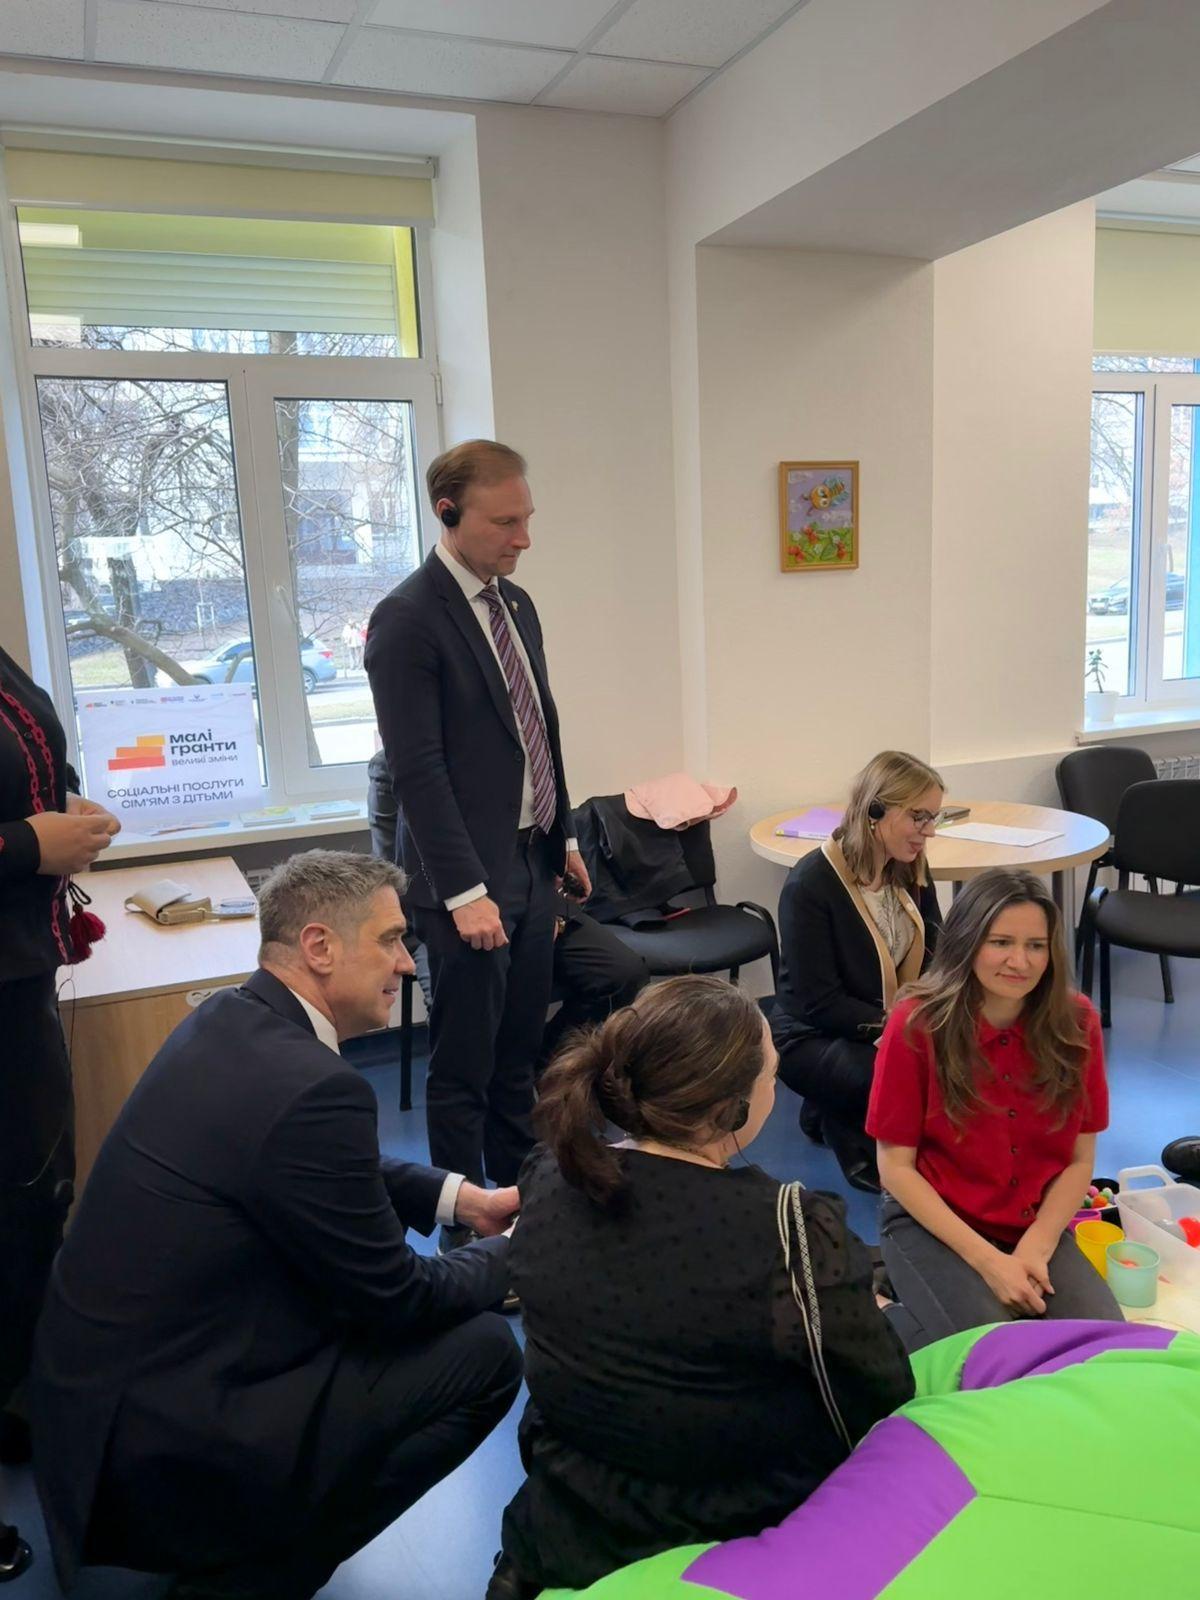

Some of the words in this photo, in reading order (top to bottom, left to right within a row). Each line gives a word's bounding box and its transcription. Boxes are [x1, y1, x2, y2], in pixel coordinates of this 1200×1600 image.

[169, 729, 212, 744] малі
[170, 739, 237, 756] гранти
[107, 784, 180, 799] СОЦІАЛЬНІ
[182, 778, 244, 791] ПОСЛУГИ
[172, 794, 181, 804] З
[183, 790, 233, 806] ДІТЬМИ
